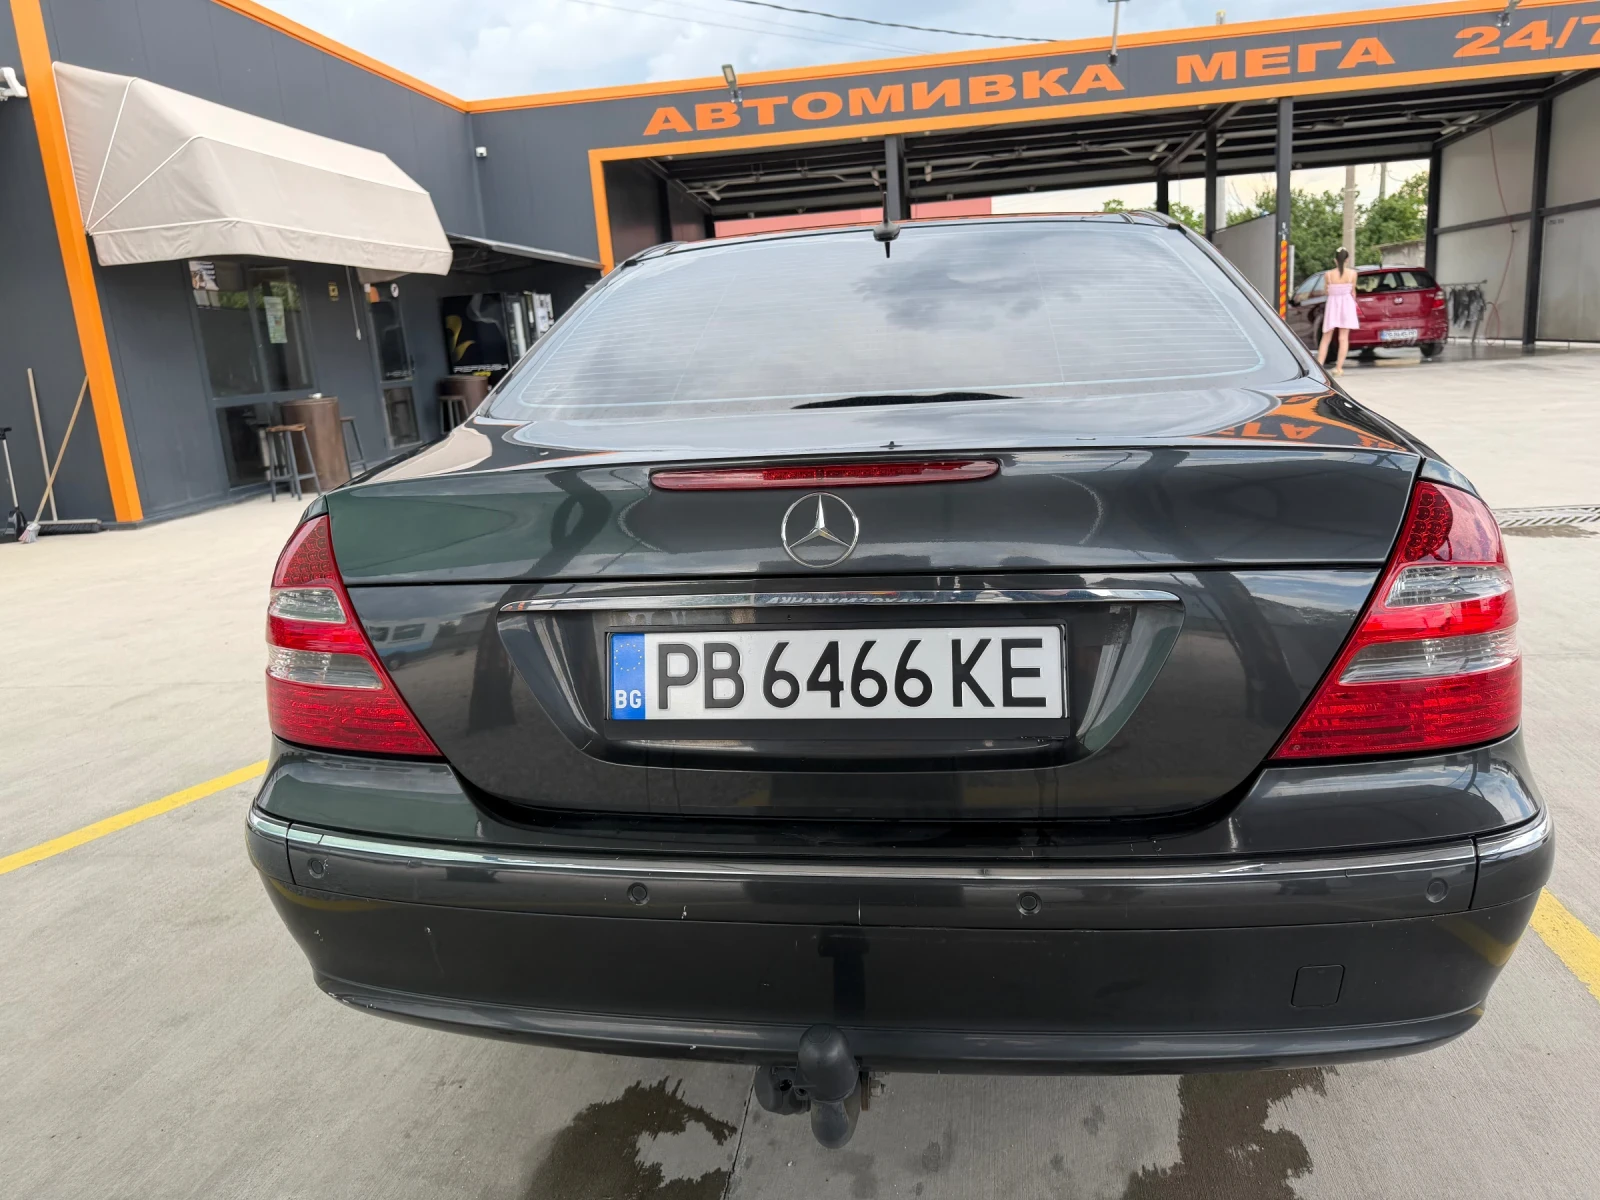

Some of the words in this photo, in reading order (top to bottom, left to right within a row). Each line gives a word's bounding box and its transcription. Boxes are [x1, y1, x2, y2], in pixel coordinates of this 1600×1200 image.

[644, 64, 1124, 136] АВТОМИВКА
[1176, 37, 1395, 84] МЕГА
[615, 689, 642, 709] BG
[658, 642, 746, 710] PB
[763, 639, 934, 710] 6466
[951, 638, 1048, 708] KE
